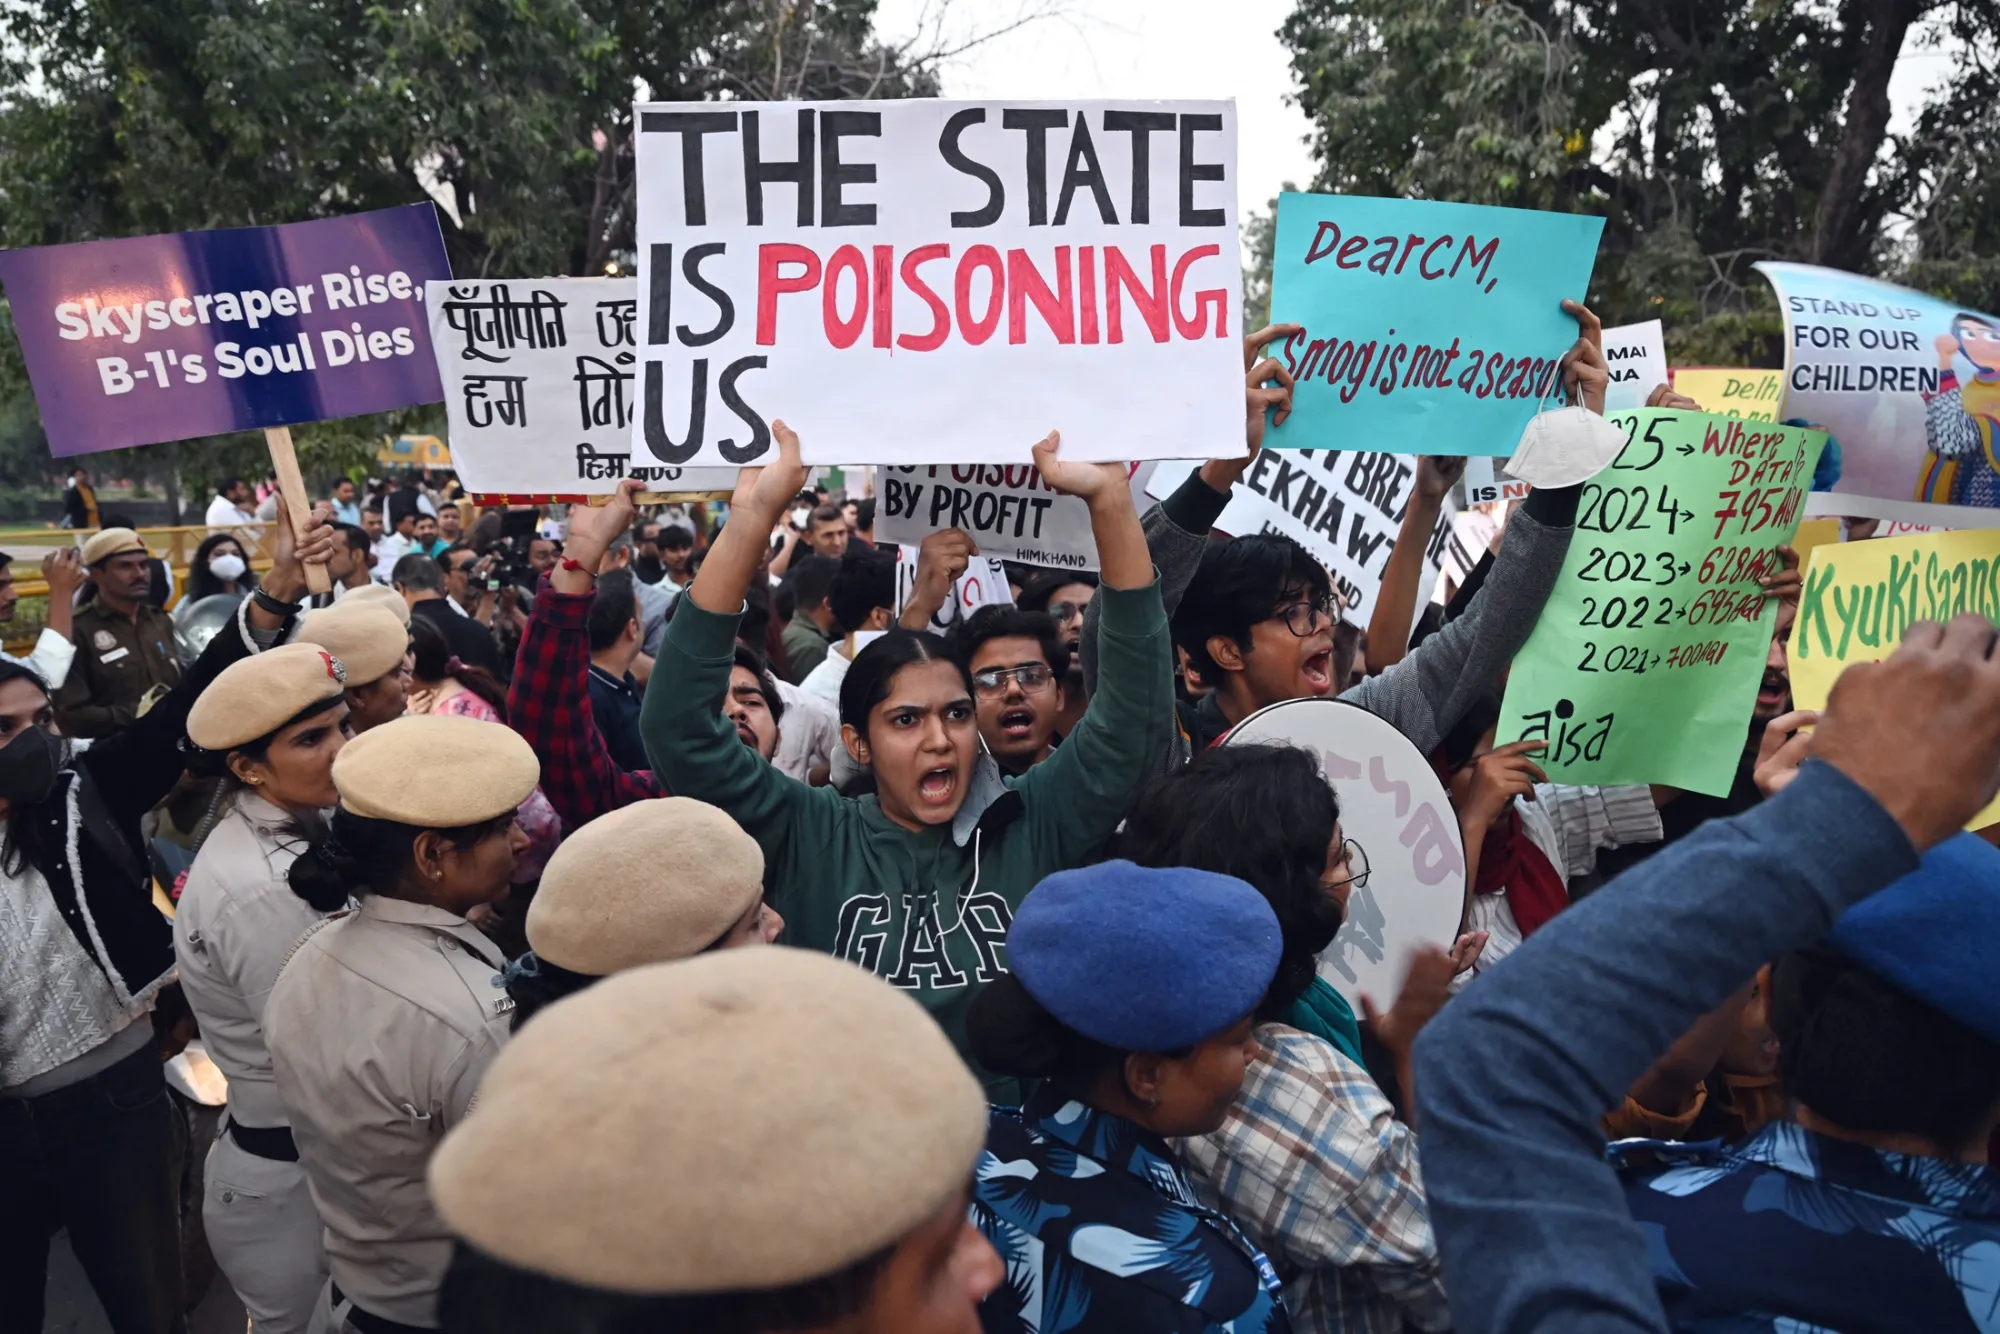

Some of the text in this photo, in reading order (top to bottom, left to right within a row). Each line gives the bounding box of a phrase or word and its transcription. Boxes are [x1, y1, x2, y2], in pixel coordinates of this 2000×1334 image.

[641, 108, 1226, 229] THE STATE
[1304, 220, 1500, 294] Dear CM,
[55, 265, 424, 344] Skyscraper Rise,
[648, 242, 1228, 355] IS POISONING
[1788, 296, 1922, 321] STAND UP
[96, 322, 414, 396] B-1's Soul Dies
[1607, 346, 1646, 361] MAI
[1794, 325, 1920, 351] FOR OUR
[1284, 327, 1377, 403] Smog
[1369, 329, 1407, 395] is
[1402, 337, 1459, 388] not
[1458, 349, 1484, 394] a
[1791, 364, 1938, 391] CHILDREN
[462, 375, 528, 428] हम
[644, 355, 771, 464] US
[1701, 421, 1785, 462] Where
[885, 479, 1053, 539] BY PROFIT
[1472, 486, 1497, 502] IS
[1577, 484, 1679, 535] 2024
[1016, 547, 1086, 568] HIMKHAND
[1577, 547, 1676, 585] 2023
[1579, 596, 1674, 629] 2022
[1577, 642, 1650, 675] 2021
[1518, 699, 1614, 767] aisa
[832, 888, 1007, 989] GAP
